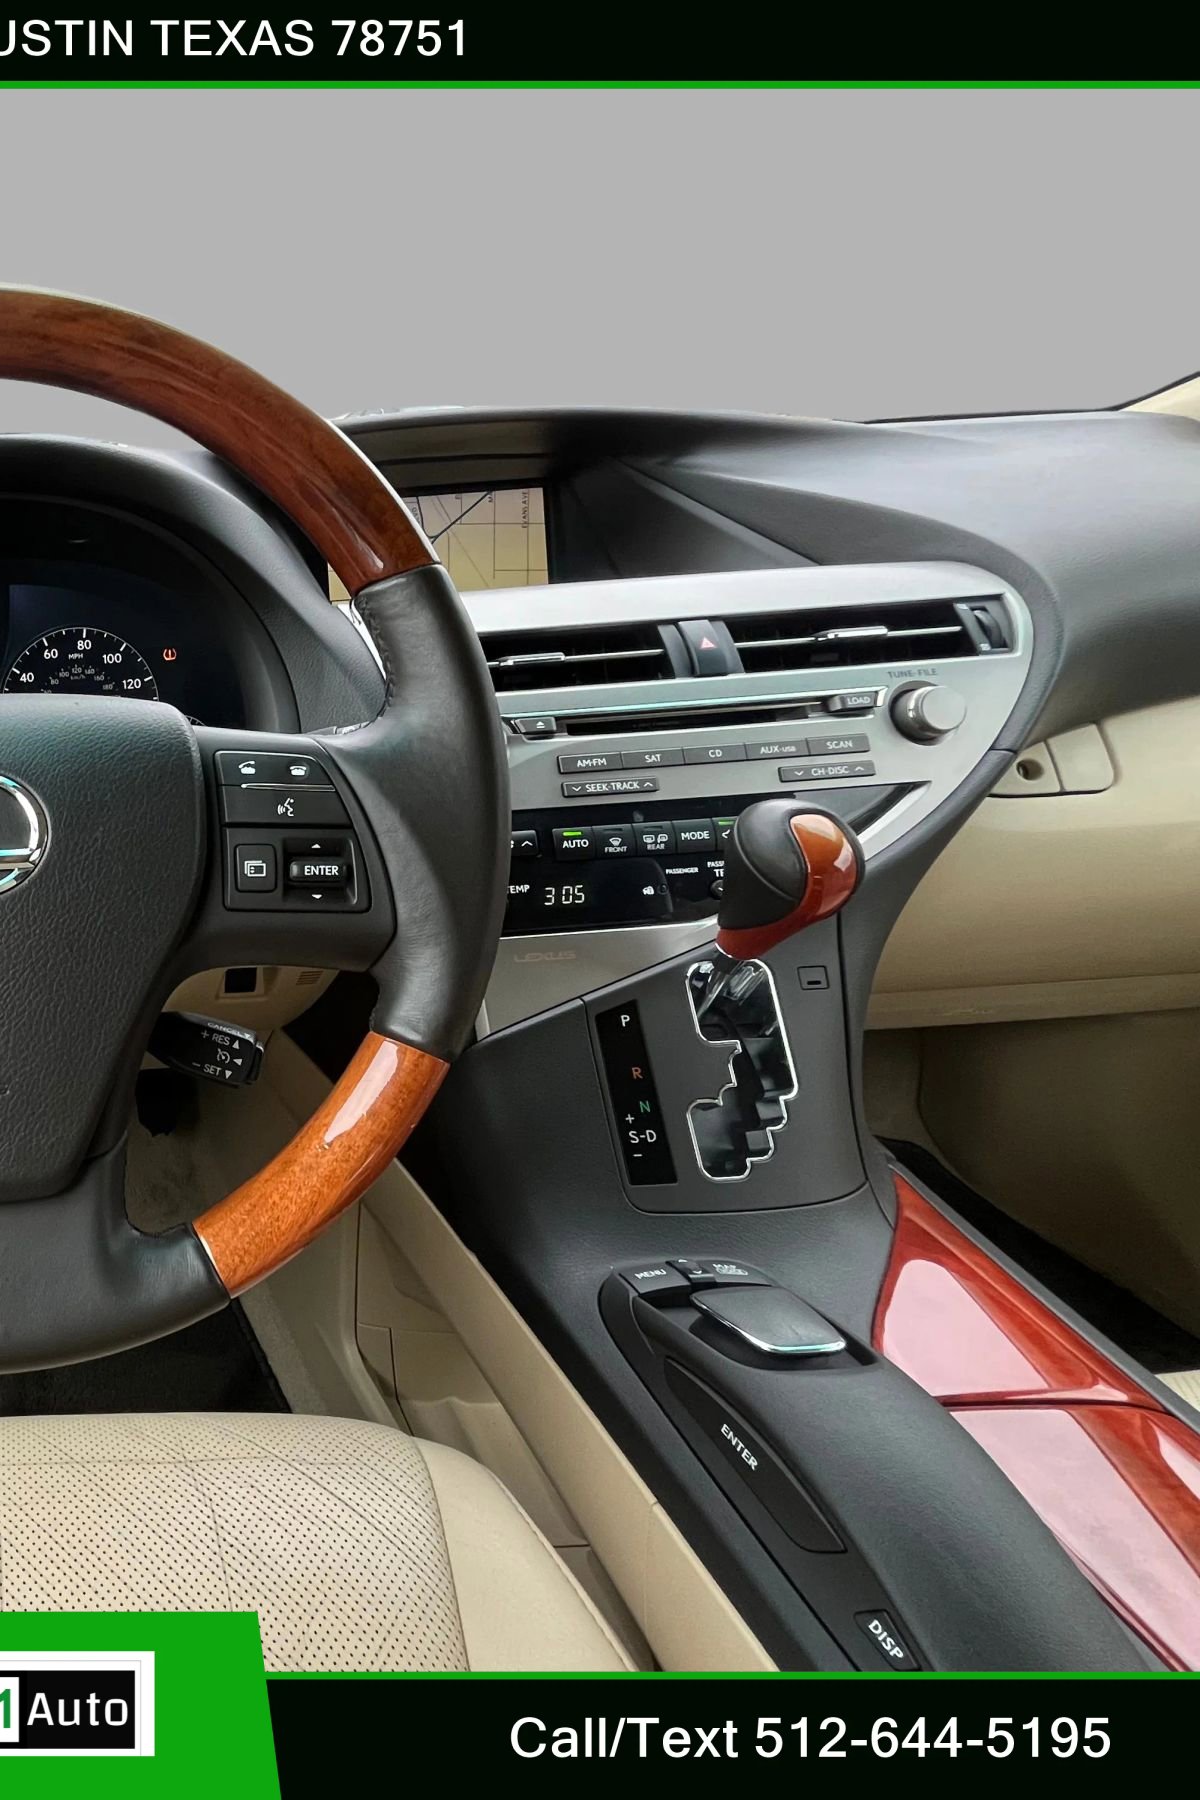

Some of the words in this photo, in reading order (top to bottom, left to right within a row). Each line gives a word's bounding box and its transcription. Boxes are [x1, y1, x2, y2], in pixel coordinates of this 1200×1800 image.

[77, 639, 92, 650] 80
[43, 648, 58, 660] 60
[102, 653, 122, 664] 100
[19, 672, 35, 683] 40
[122, 678, 142, 690] 120
[847, 695, 871, 705] LOAD
[826, 740, 853, 750] SCAN
[645, 754, 661, 764] SAT
[708, 749, 723, 758] CD
[681, 830, 710, 840] MODE
[562, 839, 589, 849] AUTO
[604, 845, 628, 854] FRONT
[304, 865, 339, 876] ENTER
[620, 1014, 631, 1027] P
[211, 1032, 231, 1046] RES
[203, 1063, 222, 1076] SET
[631, 1067, 643, 1079] R
[639, 1101, 651, 1113] N
[634, 1269, 667, 1279] MENU
[720, 1423, 759, 1471] ENTER
[868, 1619, 904, 1659] DISP
